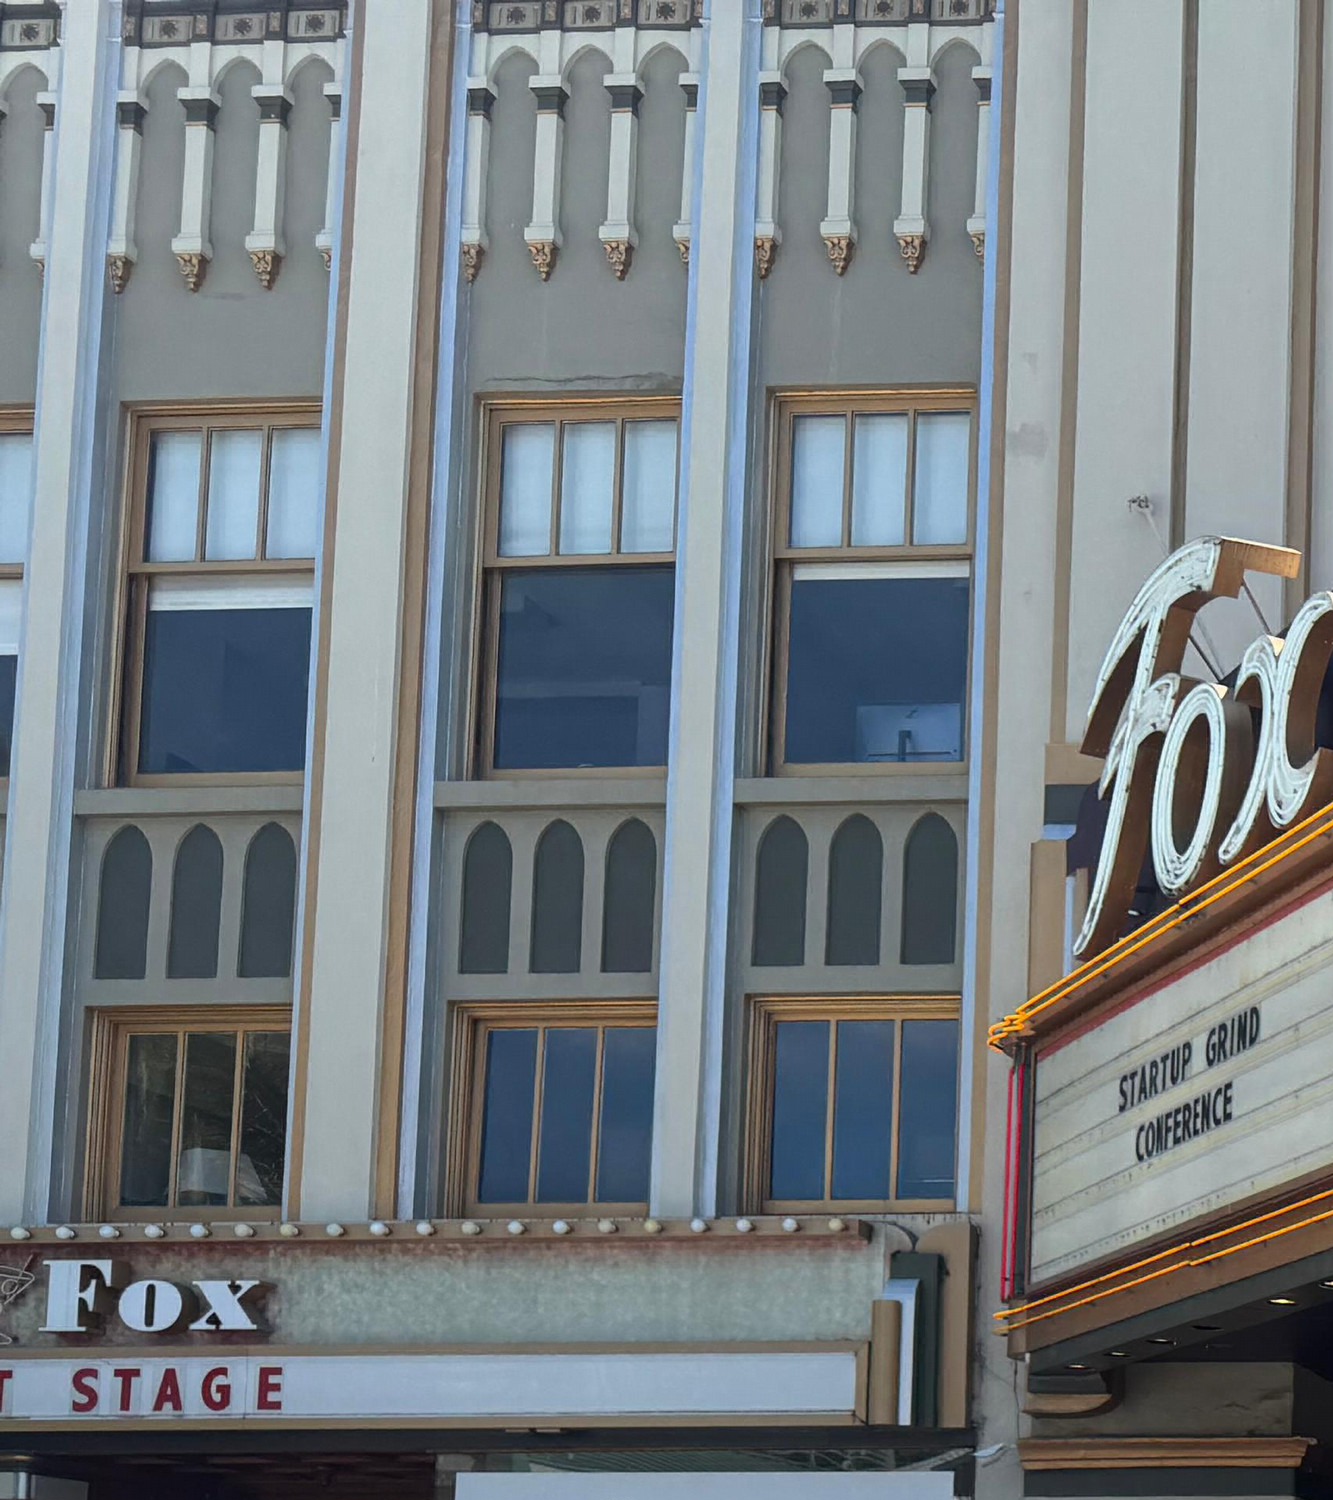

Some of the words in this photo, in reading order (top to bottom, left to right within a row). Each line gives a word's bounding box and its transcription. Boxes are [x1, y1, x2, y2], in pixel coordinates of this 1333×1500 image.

[1119, 1041, 1192, 1113] STARTUP
[1206, 1006, 1260, 1067] GRIND
[1136, 1081, 1233, 1162] CONFERENCE
[38, 1259, 260, 1332] Fox
[72, 1367, 283, 1412] STAGE
